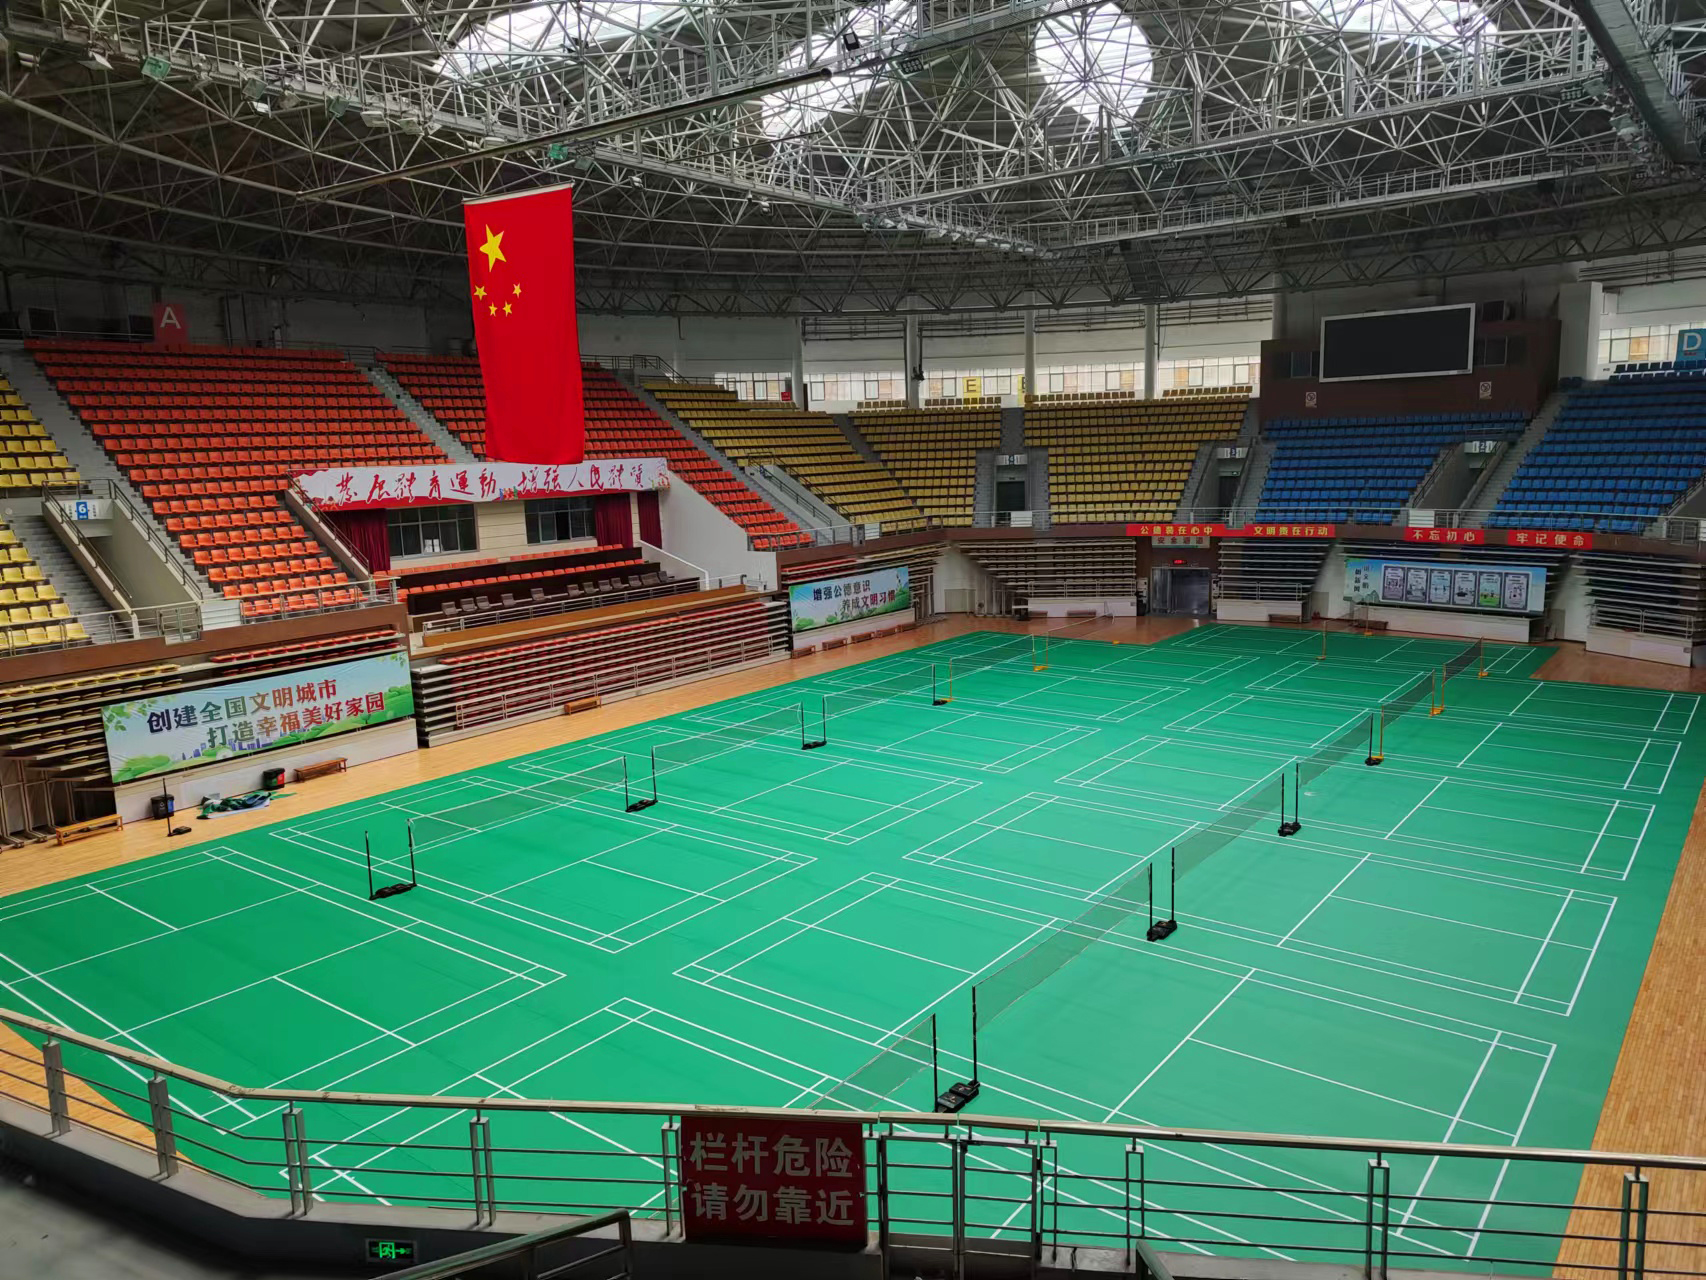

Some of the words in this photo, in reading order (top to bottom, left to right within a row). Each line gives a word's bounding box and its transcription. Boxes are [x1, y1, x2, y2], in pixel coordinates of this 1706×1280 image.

[160, 306, 181, 329] A
[1683, 333, 1702, 351] D
[966, 379, 977, 392] E
[78, 503, 87, 514] 6
[1253, 526, 1329, 536] 文明贵在行动
[1412, 529, 1476, 542] 不忘初心
[1516, 533, 1585, 547] 牢记使命
[813, 580, 871, 601] 增强公德意识
[842, 589, 896, 612] 养成文明习惯
[147, 679, 337, 734] 创建全国文明城市
[207, 691, 385, 748] 打造幸福美好家园
[689, 1131, 853, 1178] 栏杆危险
[691, 1182, 854, 1226] 请勿靠近
